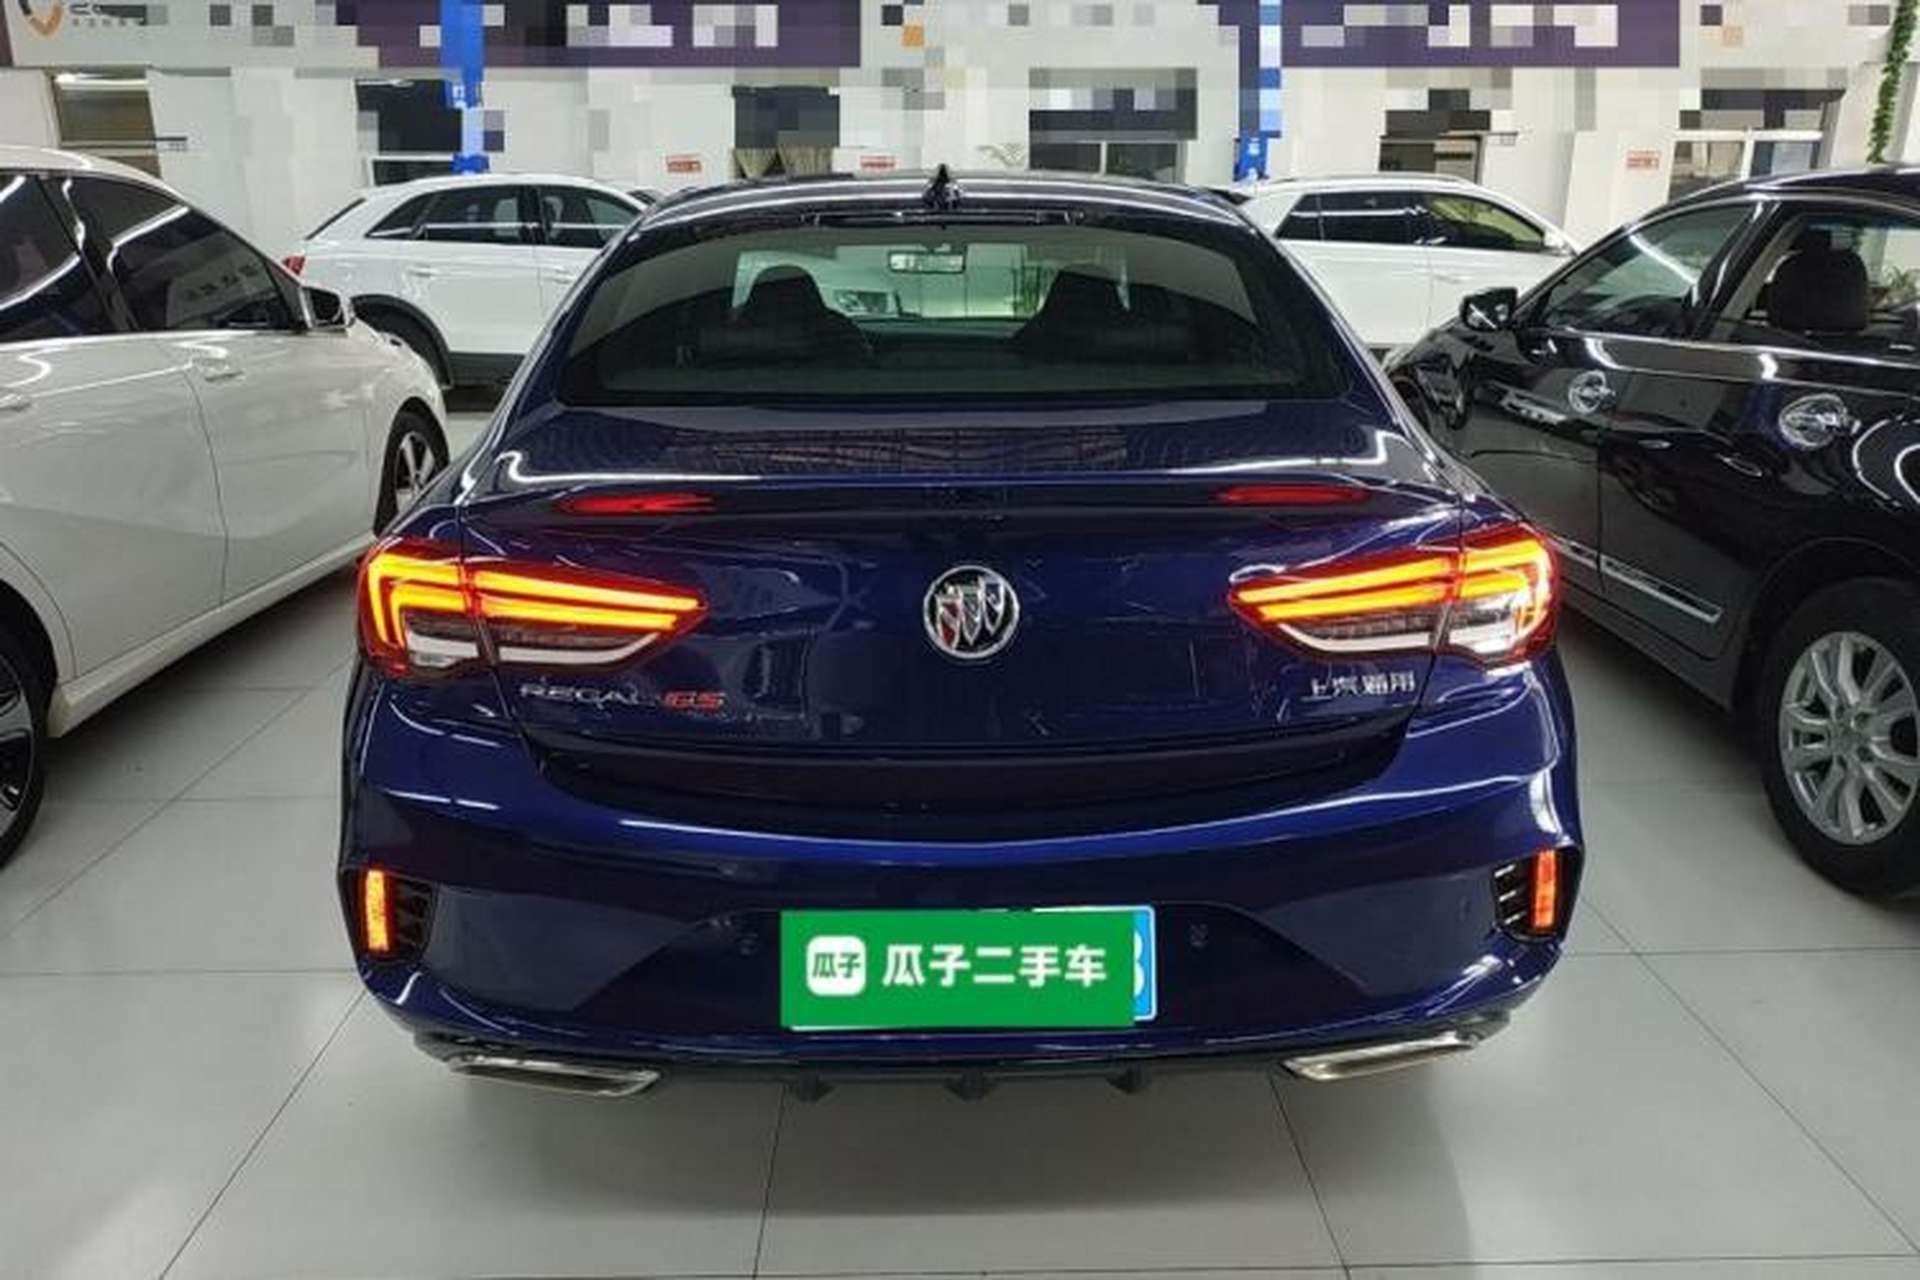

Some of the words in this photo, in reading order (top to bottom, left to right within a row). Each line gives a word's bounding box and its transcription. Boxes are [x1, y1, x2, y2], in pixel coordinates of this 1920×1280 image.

[519, 683, 655, 707] REGAL
[663, 689, 727, 709] GS
[1300, 670, 1416, 702] 上汽通用
